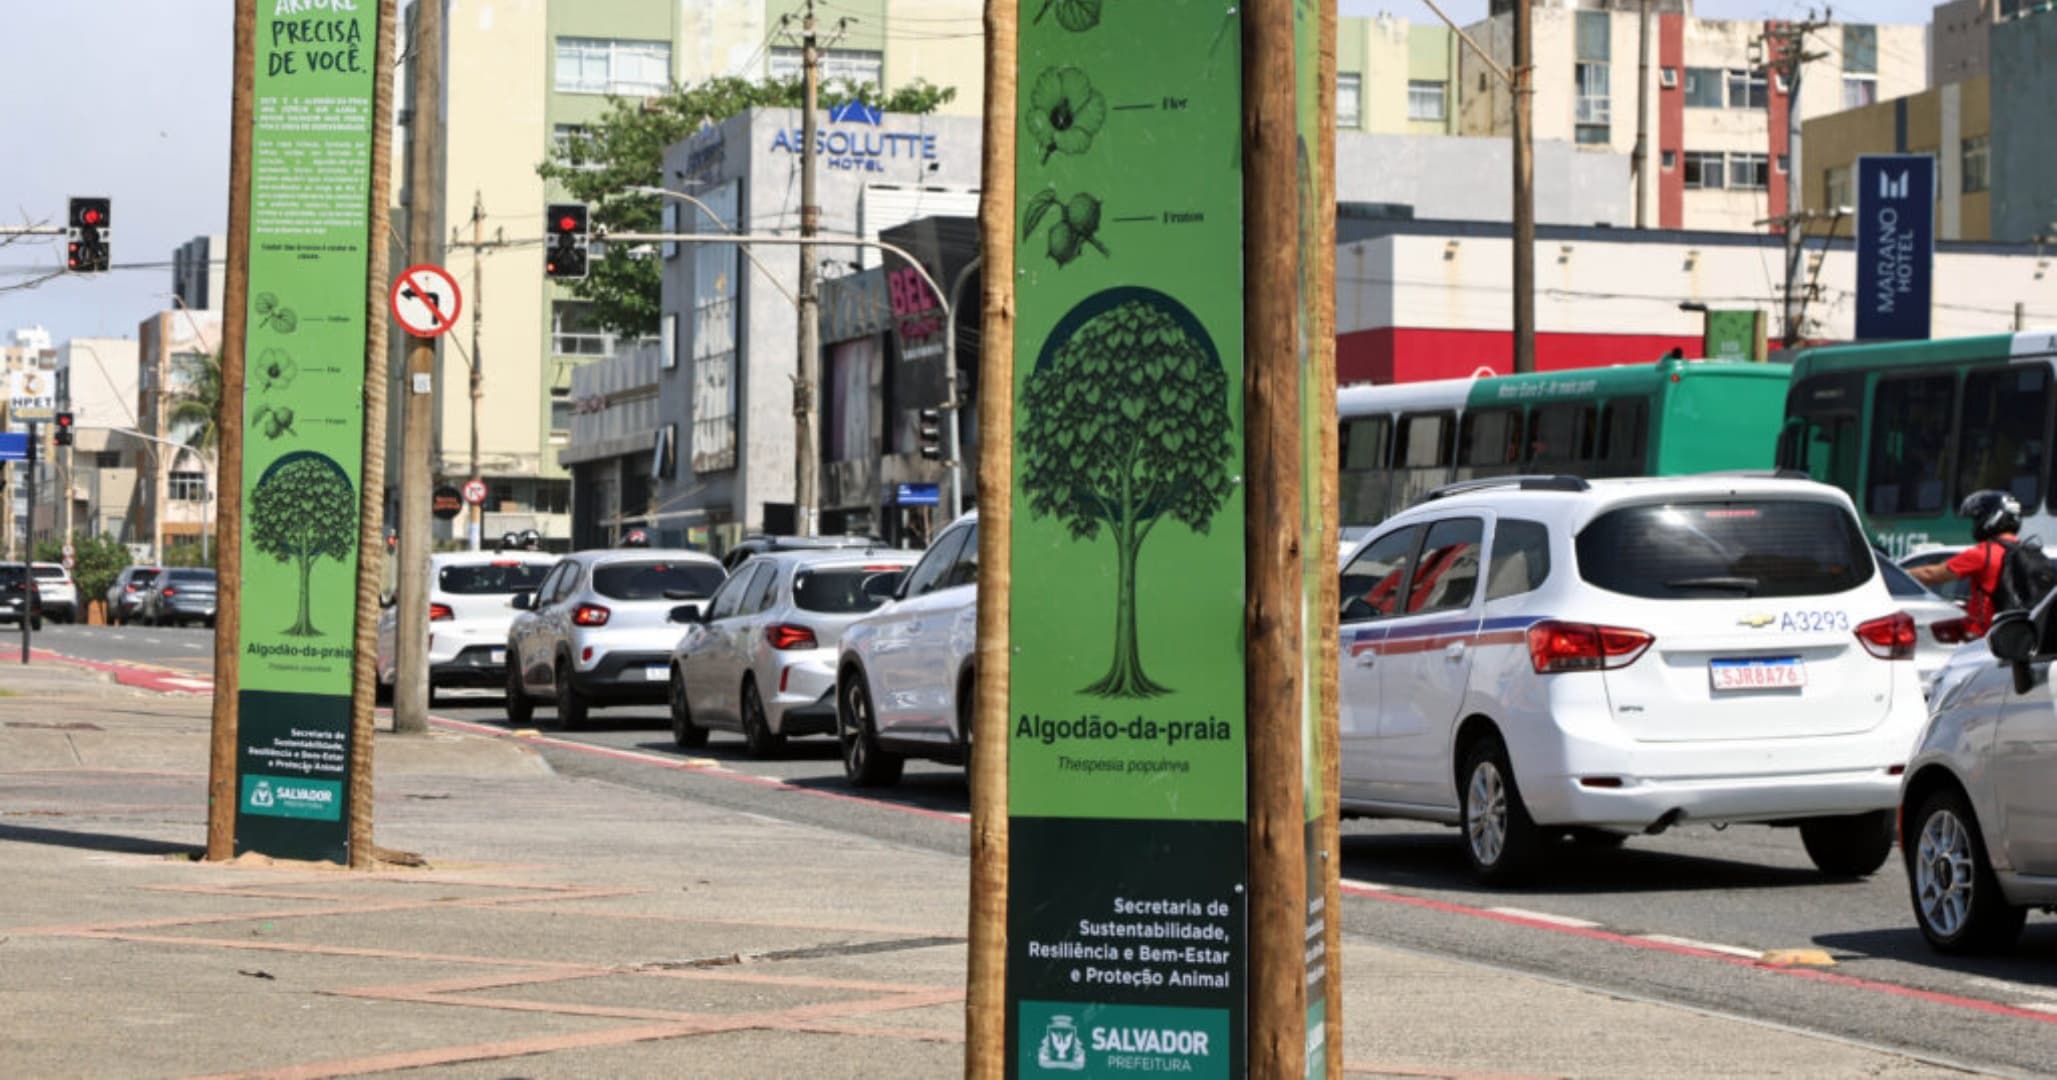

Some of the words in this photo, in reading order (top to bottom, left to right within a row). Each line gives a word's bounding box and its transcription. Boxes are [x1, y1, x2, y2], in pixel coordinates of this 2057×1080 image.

[272, 18, 361, 47] PRECISA
[269, 51, 296, 77] DE
[306, 44, 367, 73] VOCÊ.
[770, 128, 937, 159] ABSOLUTTE
[828, 157, 885, 172] HOTEL
[1877, 207, 1897, 313] MARANO
[1897, 229, 1913, 293] HOTEL
[1781, 611, 1849, 631] A3293
[247, 643, 353, 659] Algodão-da-praia
[291, 728, 332, 739] Secretaria
[335, 731, 345, 740] de
[1015, 714, 1231, 747] Algodão-da-praia
[276, 787, 332, 802] SALVADOR
[1114, 897, 1201, 916] Secretaria
[1207, 900, 1229, 916] de
[1079, 919, 1229, 943] Sustentabilidade,
[1028, 941, 1119, 960] Resiliência
[1123, 948, 1134, 961] e
[1139, 945, 1230, 964] Bem-Estar
[1070, 969, 1080, 983] e
[1086, 967, 1163, 986] Proteção
[1169, 971, 1229, 987] Animal
[1091, 1027, 1209, 1056] SALVADOR
[1108, 1056, 1193, 1072] PREFEITURA
